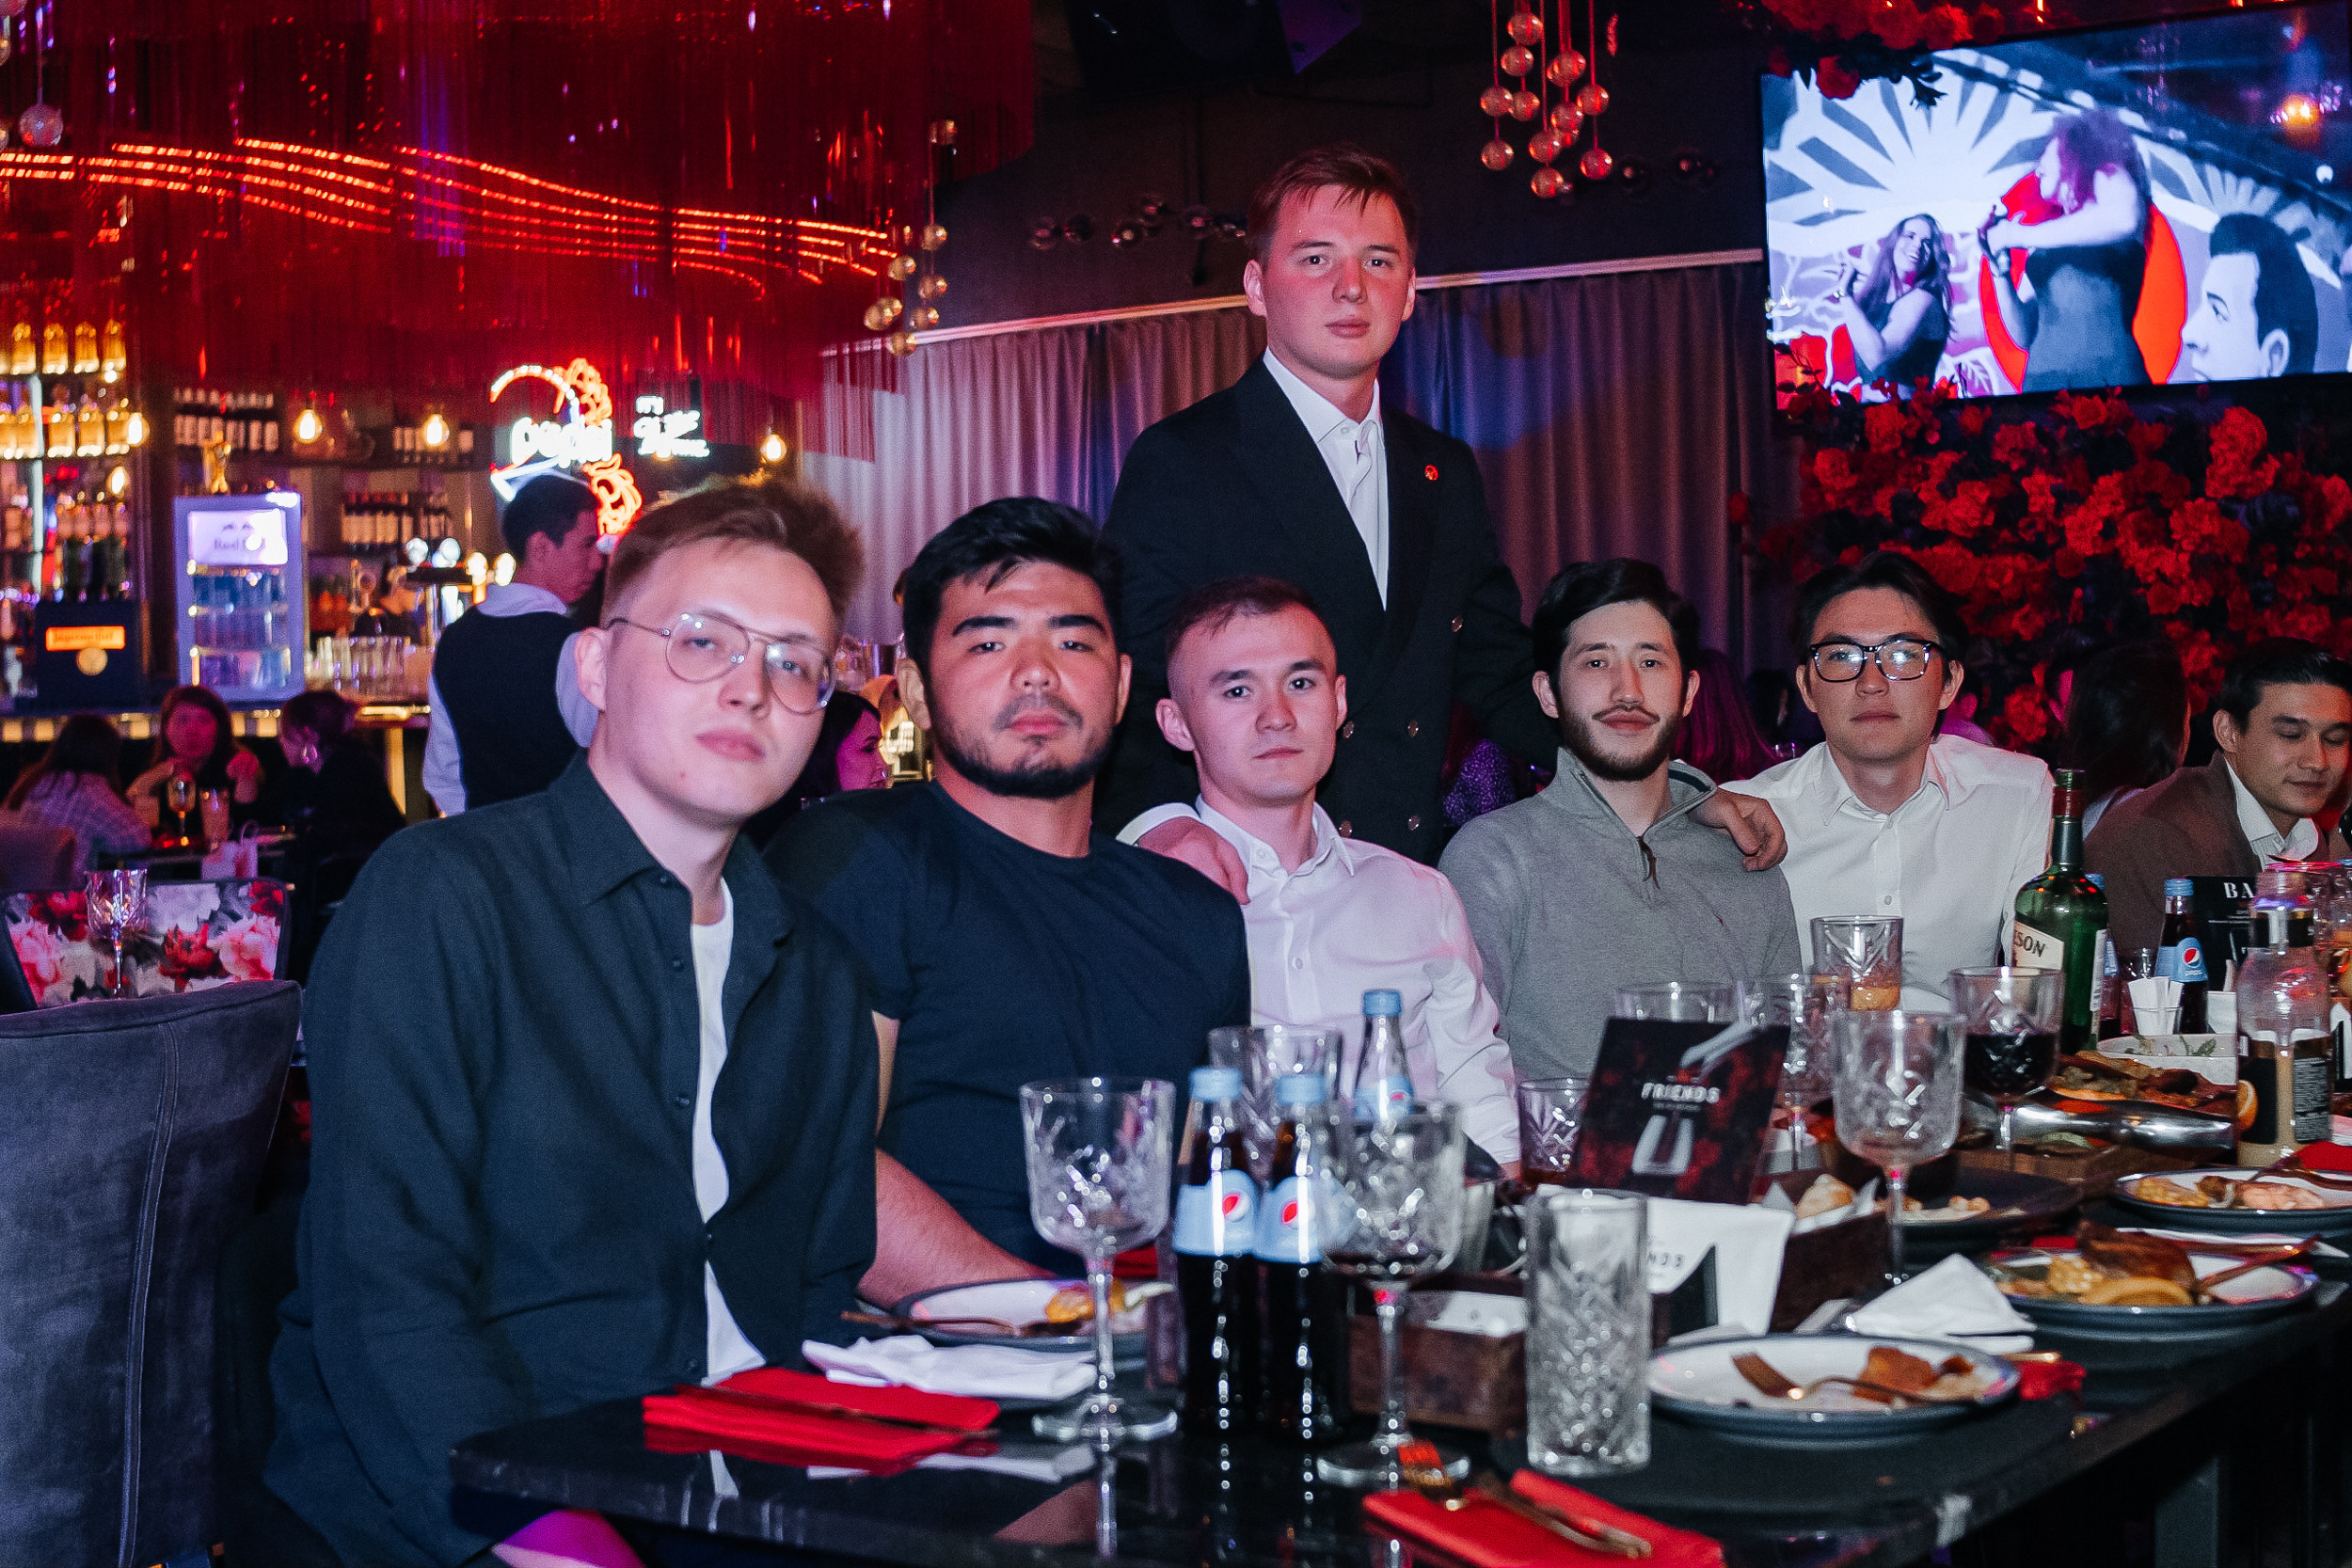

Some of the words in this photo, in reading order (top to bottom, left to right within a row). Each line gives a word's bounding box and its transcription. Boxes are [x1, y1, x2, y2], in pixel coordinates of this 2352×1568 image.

[2223, 881, 2256, 899] BA
[2014, 929, 2046, 958] SON
[1641, 1082, 1721, 1104] FRIENDS
